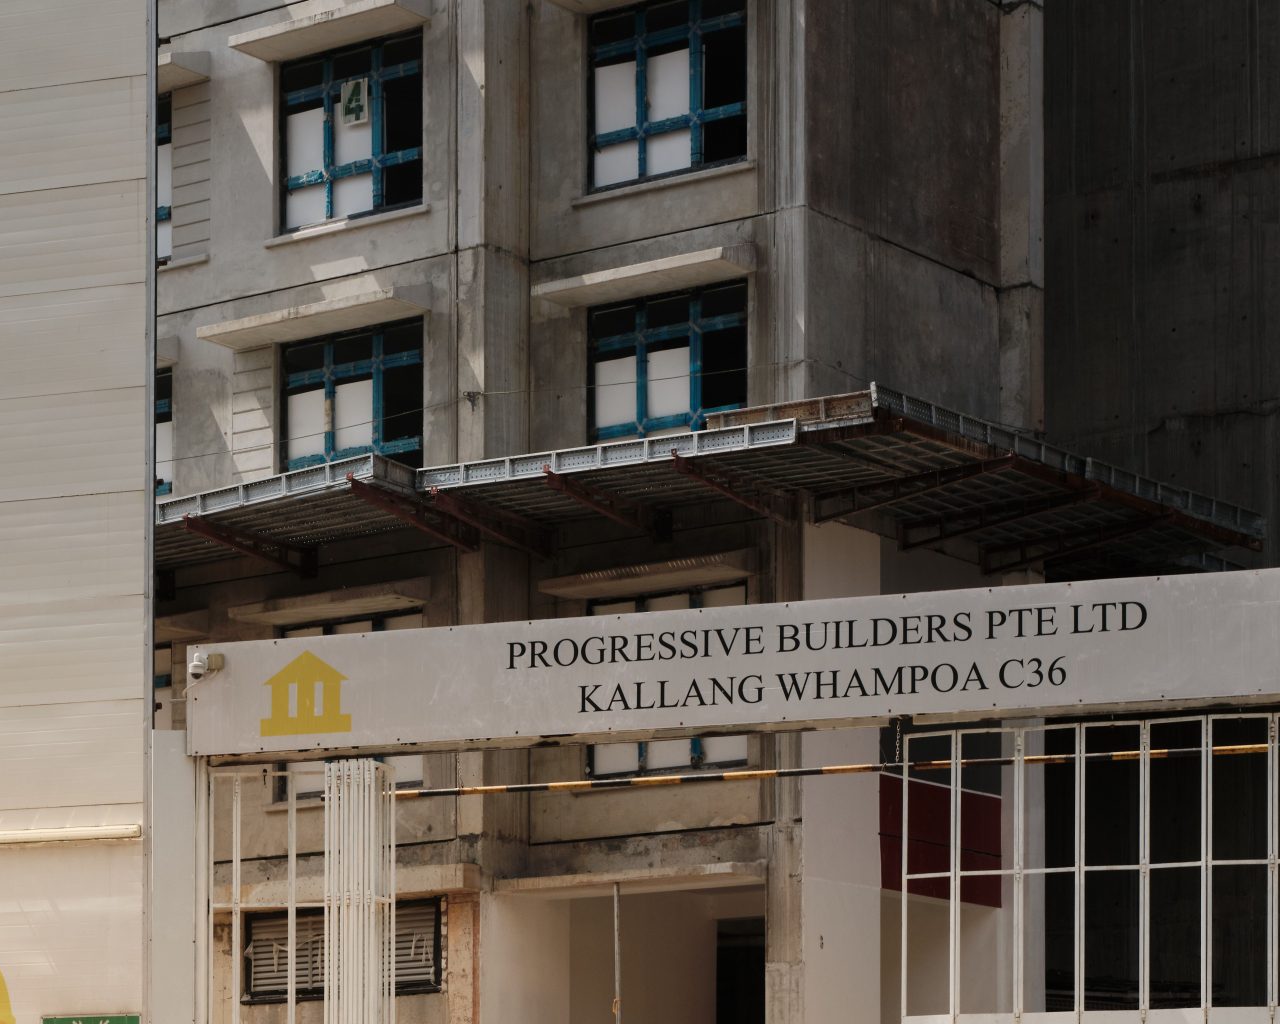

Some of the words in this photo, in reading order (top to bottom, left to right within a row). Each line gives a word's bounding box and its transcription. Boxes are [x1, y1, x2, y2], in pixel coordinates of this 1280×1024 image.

[344, 81, 364, 120] 4
[506, 625, 765, 669] PROGRESSIVE
[776, 611, 973, 653] BUILDERS
[985, 606, 1058, 640] PTE
[1070, 600, 1148, 634] LTD
[578, 674, 766, 714] KALLANG
[776, 661, 990, 702] WHAMPOA
[998, 655, 1068, 689] C36
